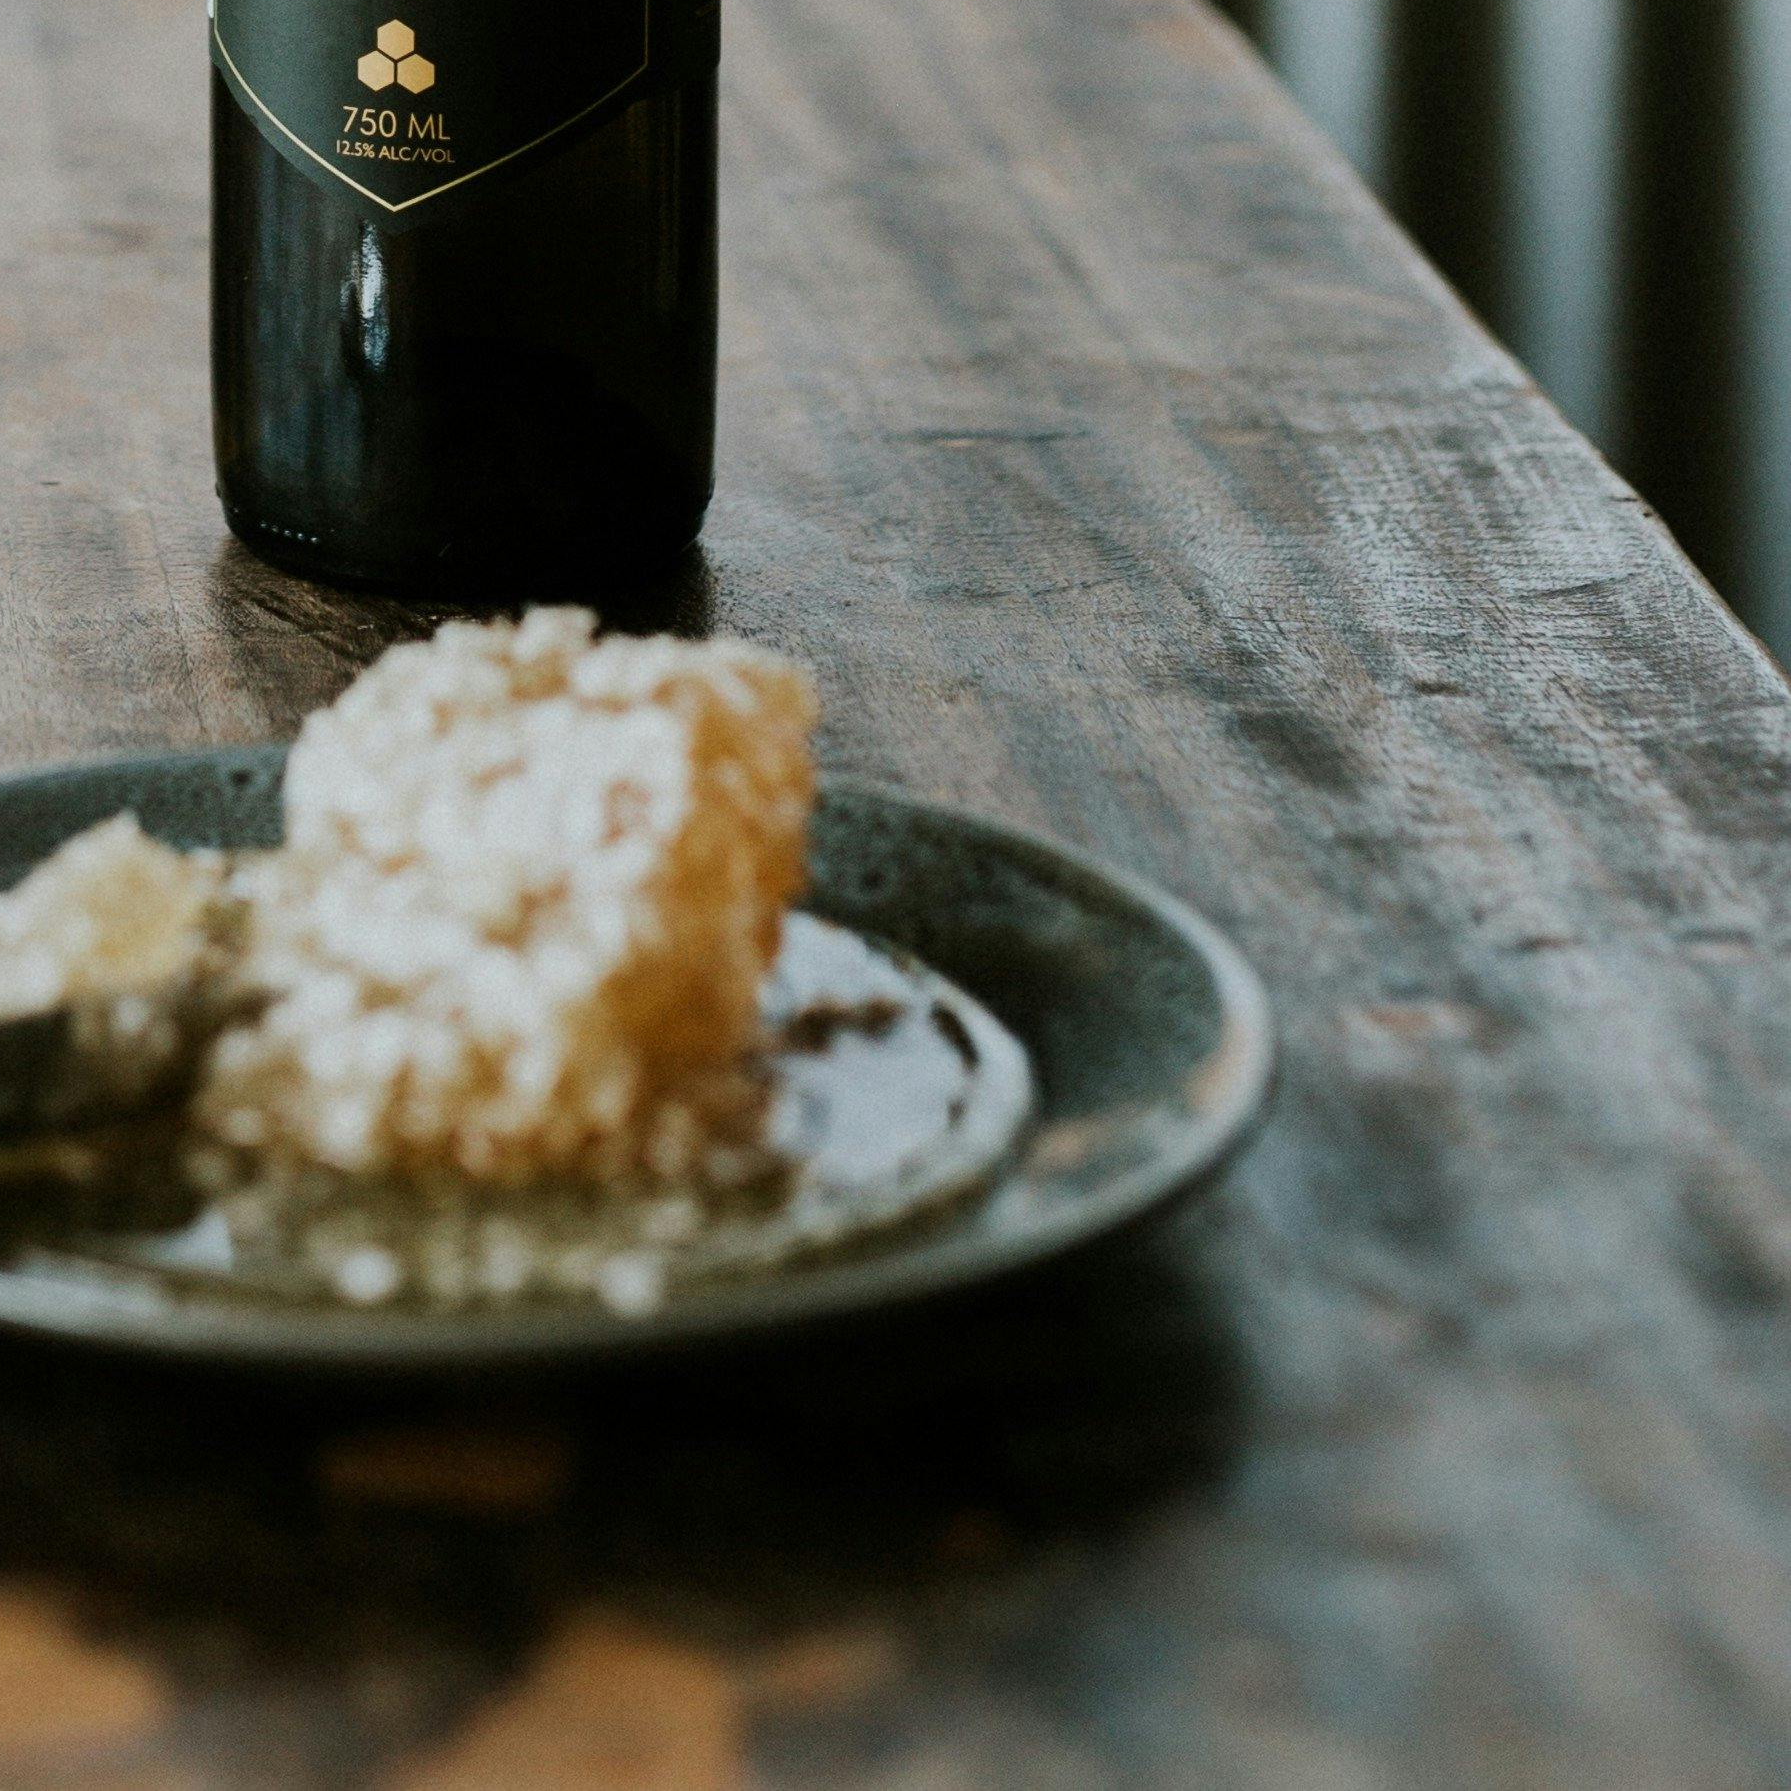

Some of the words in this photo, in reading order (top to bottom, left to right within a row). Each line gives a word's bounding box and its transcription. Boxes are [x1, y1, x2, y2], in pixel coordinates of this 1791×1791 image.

[342, 105, 397, 138] 750
[408, 113, 451, 140] ML
[336, 139, 375, 158] 12.5%
[378, 145, 456, 163] ALC/VOL
